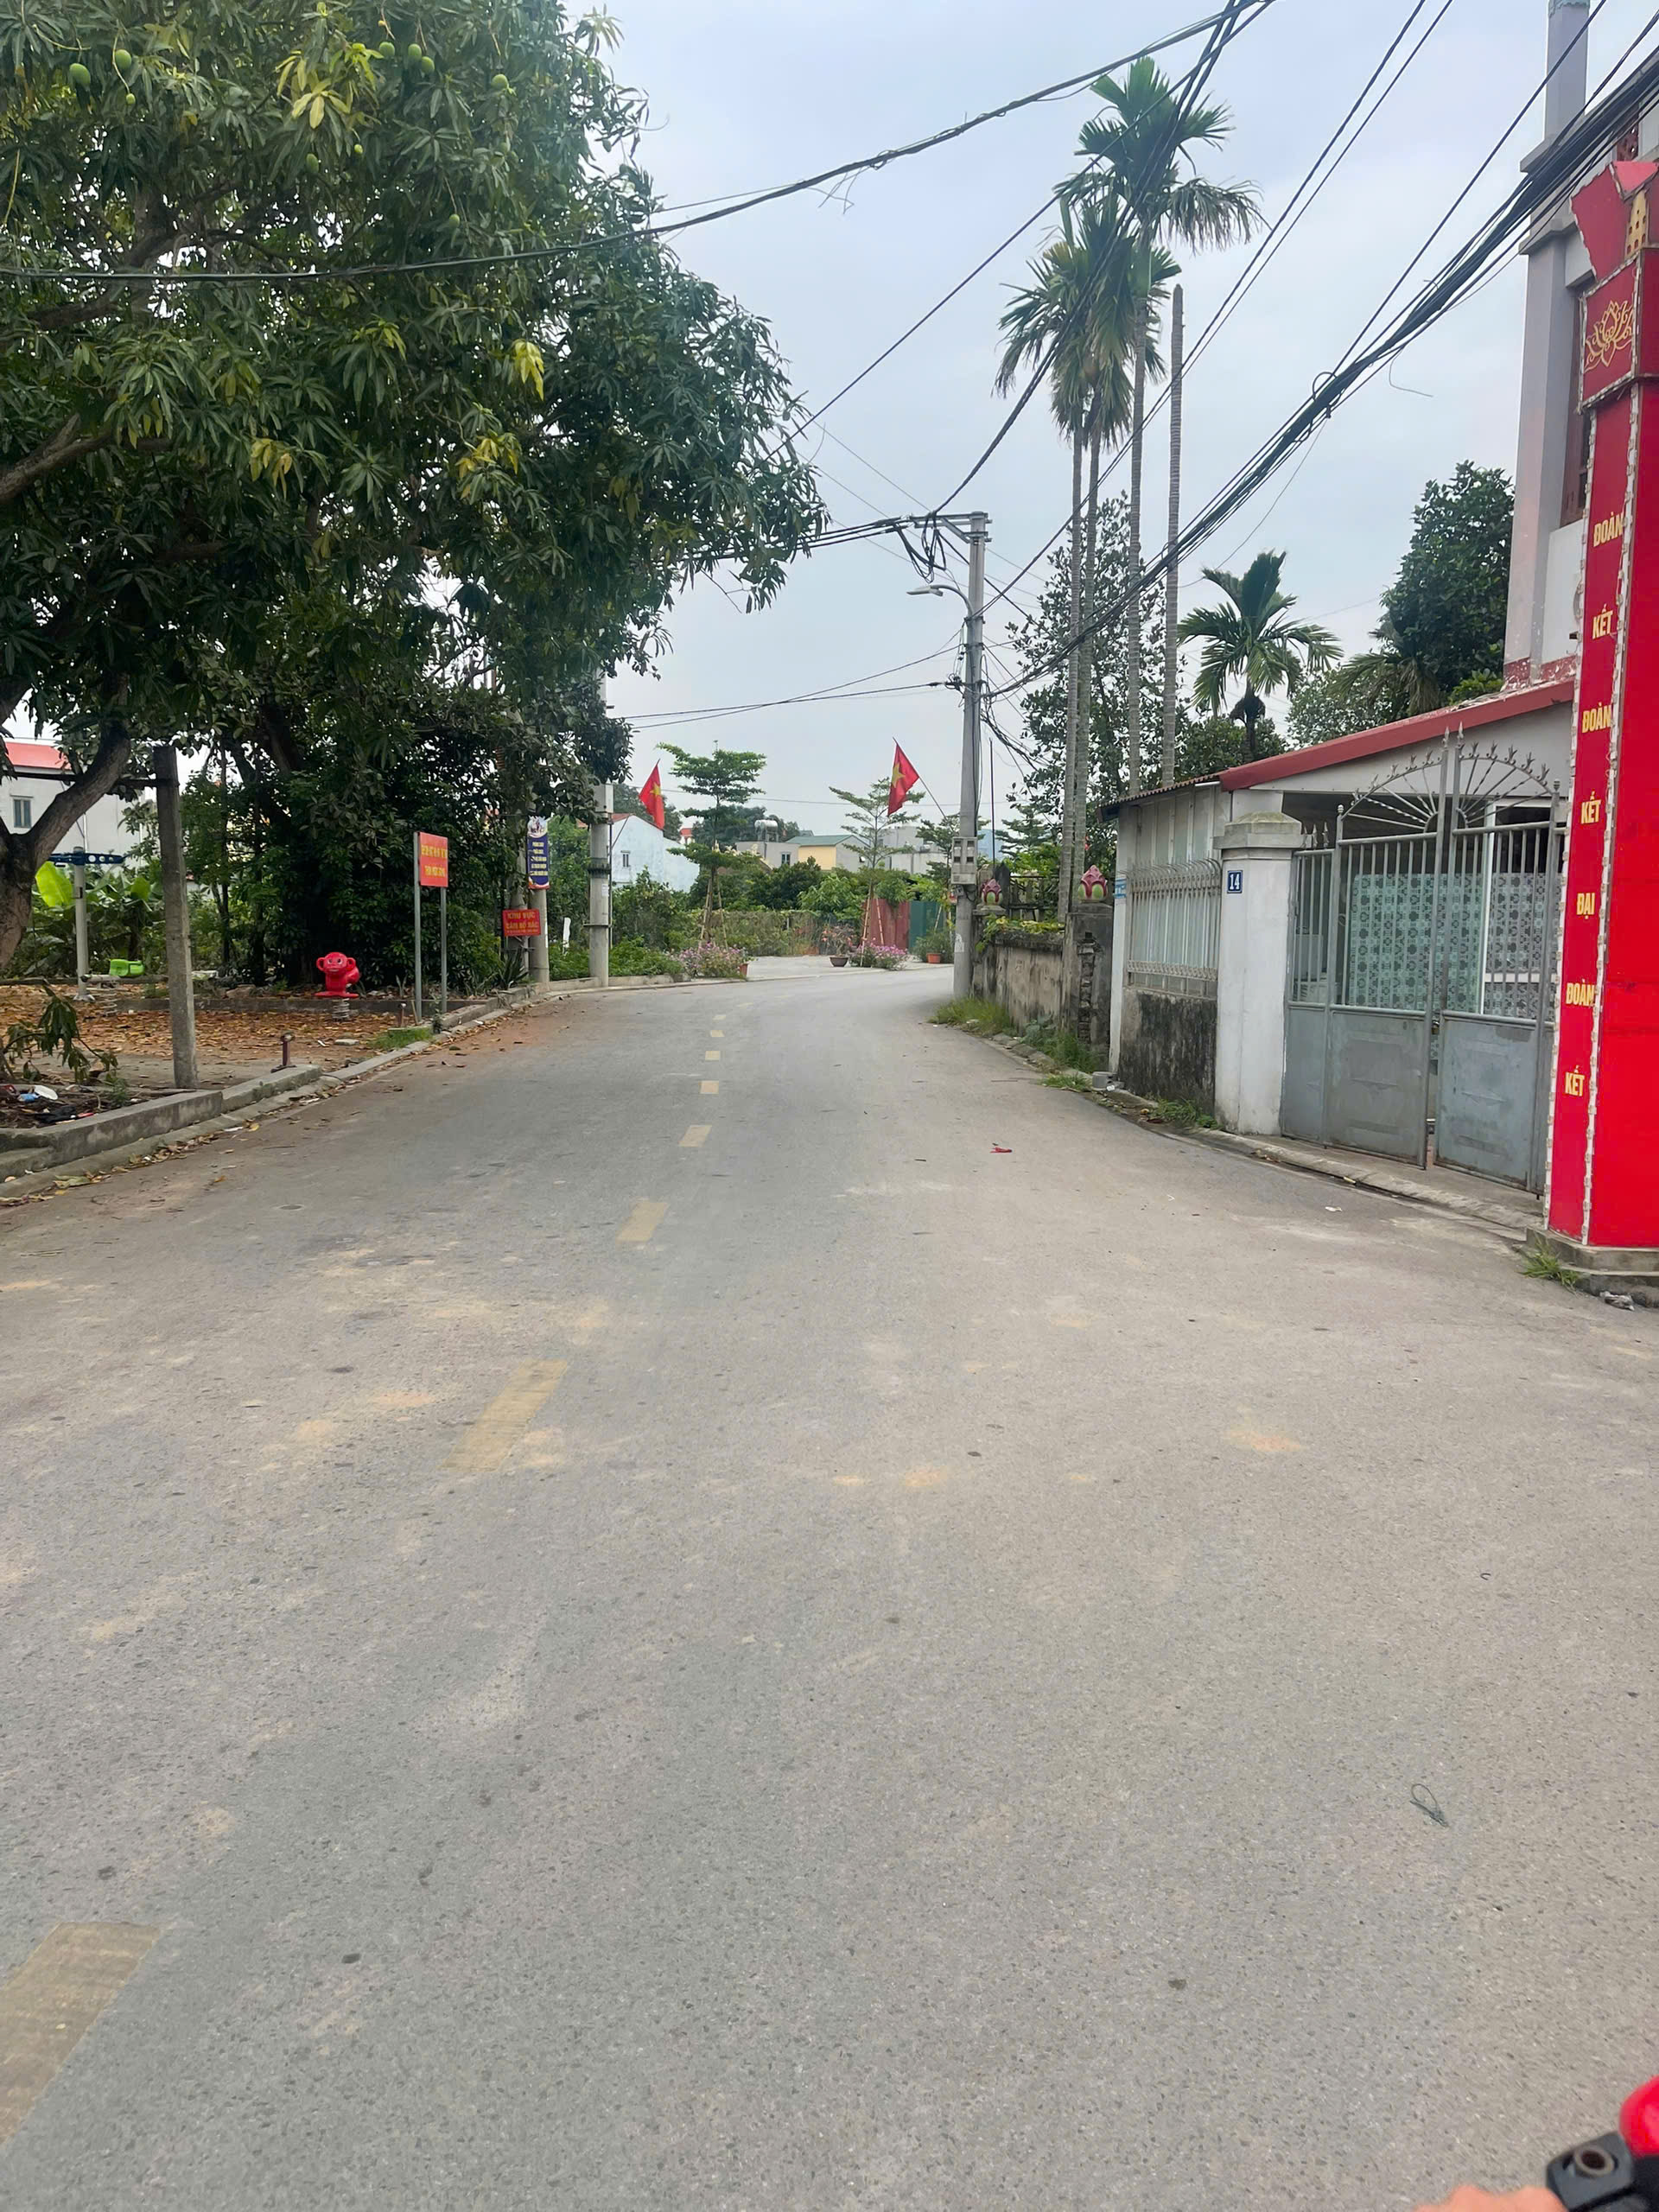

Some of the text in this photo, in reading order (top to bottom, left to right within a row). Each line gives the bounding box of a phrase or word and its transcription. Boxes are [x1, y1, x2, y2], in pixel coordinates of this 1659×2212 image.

[1593, 511, 1624, 547] ĐOÀN
[1592, 603, 1613, 639] KẾT
[1582, 702, 1611, 733] ĐOÀN
[1580, 791, 1601, 824] KẾT
[1230, 874, 1240, 890] 14
[1576, 893, 1595, 919] ĐẠI
[1566, 978, 1595, 1007] ĐOÀN
[1565, 1065, 1585, 1096] KẾT
